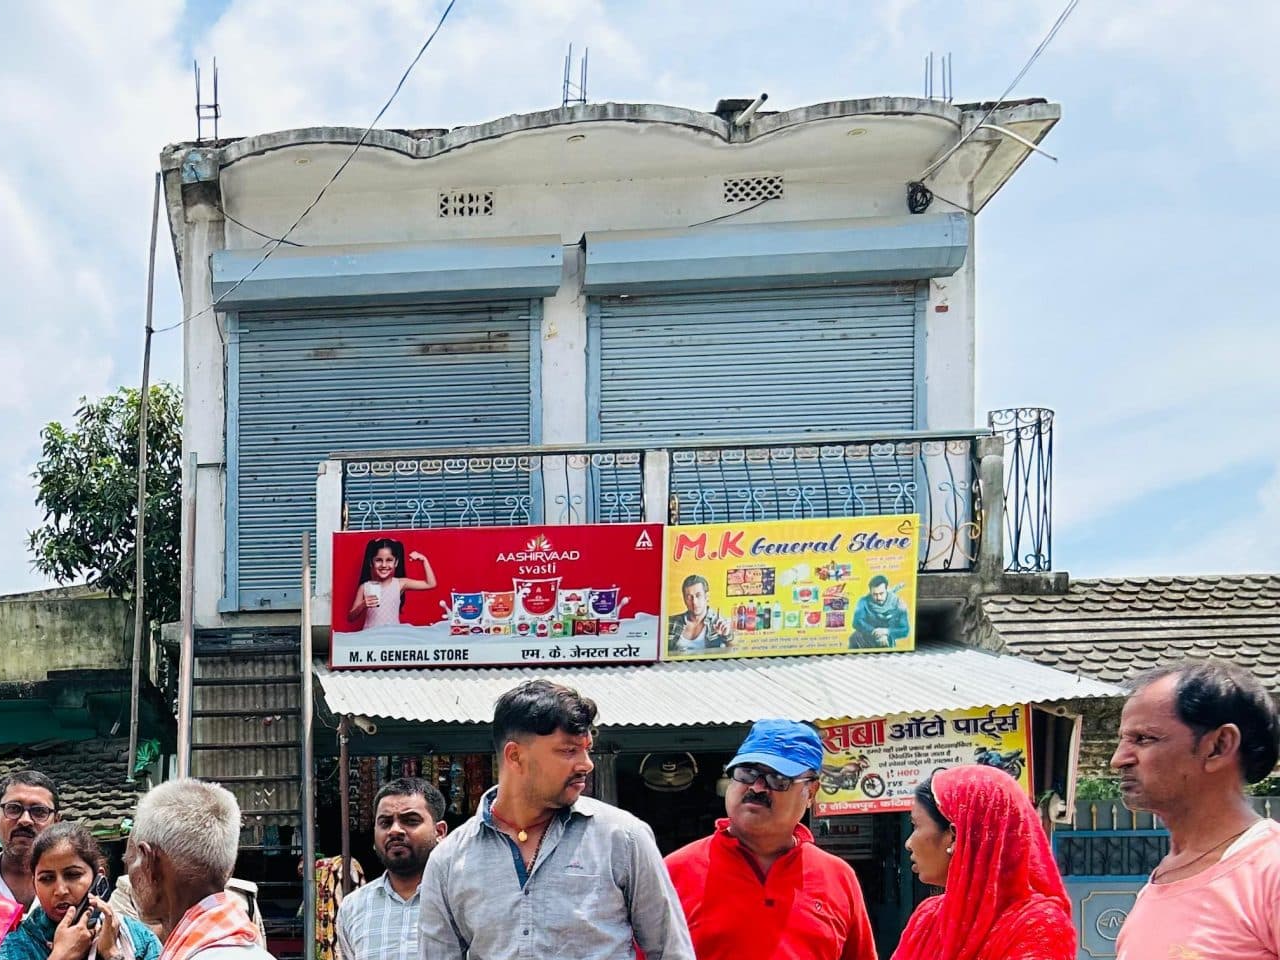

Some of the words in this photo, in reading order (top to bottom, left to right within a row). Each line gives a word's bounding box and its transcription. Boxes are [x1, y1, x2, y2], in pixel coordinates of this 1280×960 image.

[674, 531, 745, 561] M.K
[750, 534, 842, 556] General
[847, 532, 910, 551] Store
[496, 551, 580, 562] AASHIRVAAD
[519, 562, 556, 574] svasti
[349, 651, 362, 662] M.
[366, 650, 376, 662] K.
[380, 649, 430, 662] GENERAL
[433, 649, 469, 661] STORE
[569, 645, 609, 659] जेनरल
[612, 644, 640, 658] स्टोर
[889, 715, 946, 740] ऑटो
[952, 708, 1019, 739] पार्ट्स
